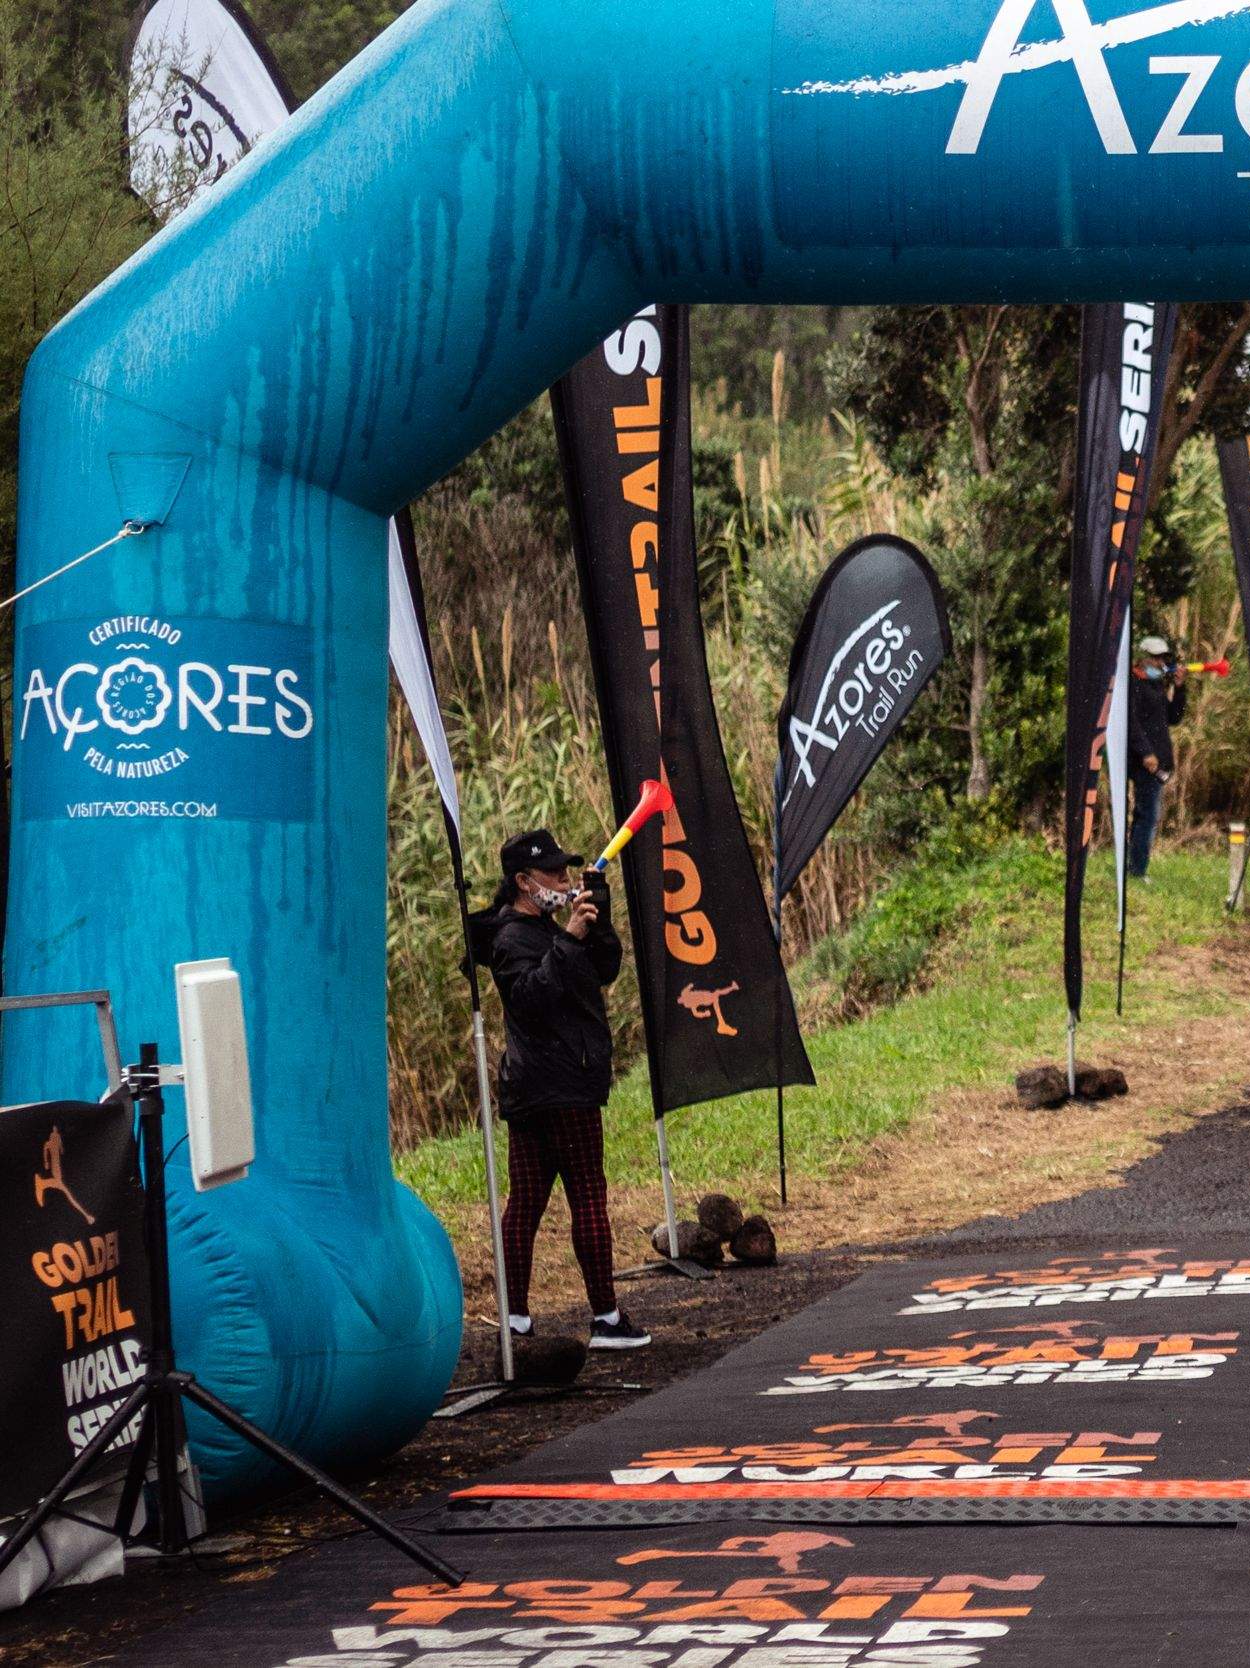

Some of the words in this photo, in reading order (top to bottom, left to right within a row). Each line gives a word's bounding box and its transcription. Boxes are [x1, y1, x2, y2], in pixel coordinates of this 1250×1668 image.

[1119, 302, 1155, 454] SERI
[88, 616, 182, 645] CERTIFICADO
[789, 619, 904, 788] Azores
[855, 686, 896, 738] Trail
[887, 649, 923, 696] Run
[83, 747, 113, 776] PELA
[116, 747, 190, 780] NATUREZA
[66, 801, 218, 818] VISITAZORES.COM
[32, 1230, 119, 1288] GOLDE
[51, 1275, 136, 1350] TRAIL
[62, 1339, 148, 1407] WORLD
[610, 1464, 1142, 1485] WORLD
[392, 1574, 1045, 1600] GOLDEN
[367, 1592, 1033, 1625] TRAIL
[331, 1620, 1010, 1650] WORLD
